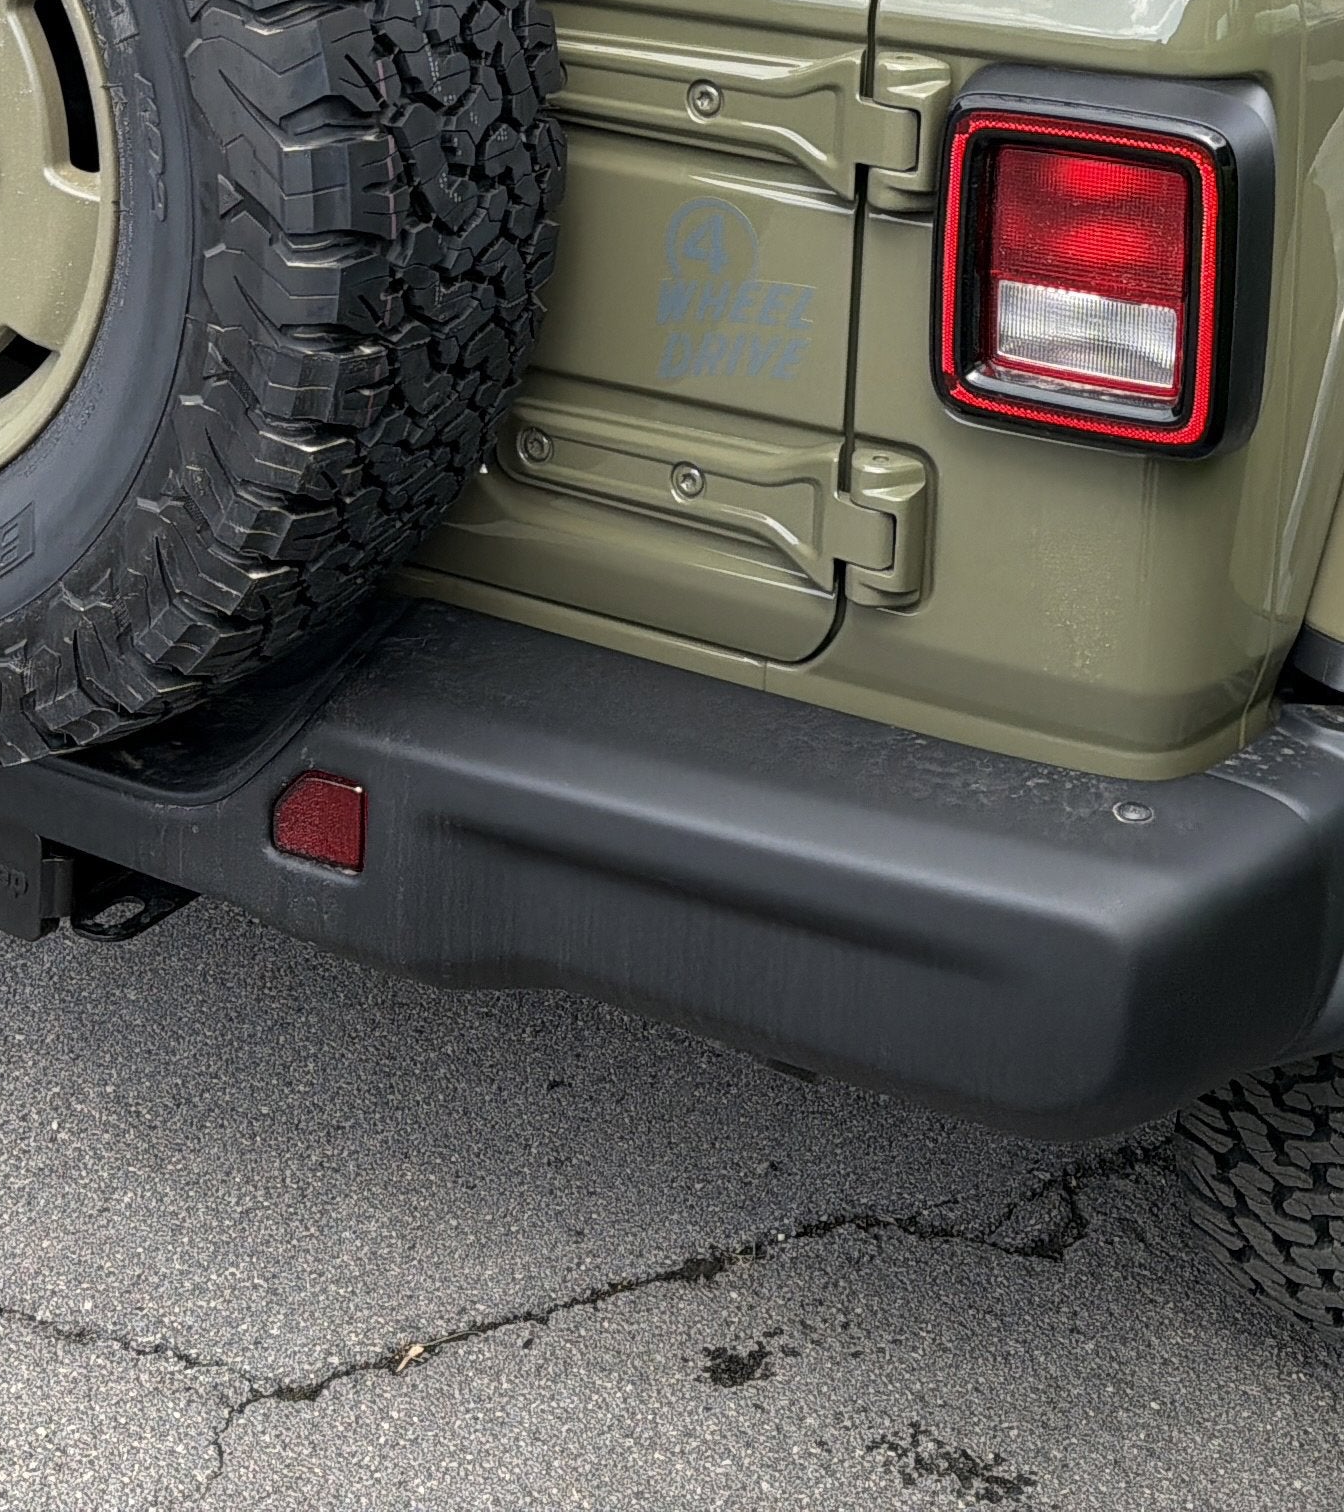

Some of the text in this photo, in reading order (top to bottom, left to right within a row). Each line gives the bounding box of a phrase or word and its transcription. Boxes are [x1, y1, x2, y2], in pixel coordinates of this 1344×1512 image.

[683, 213, 729, 276] 4
[655, 279, 817, 331] WHEEL
[657, 331, 815, 383] DRIVE
